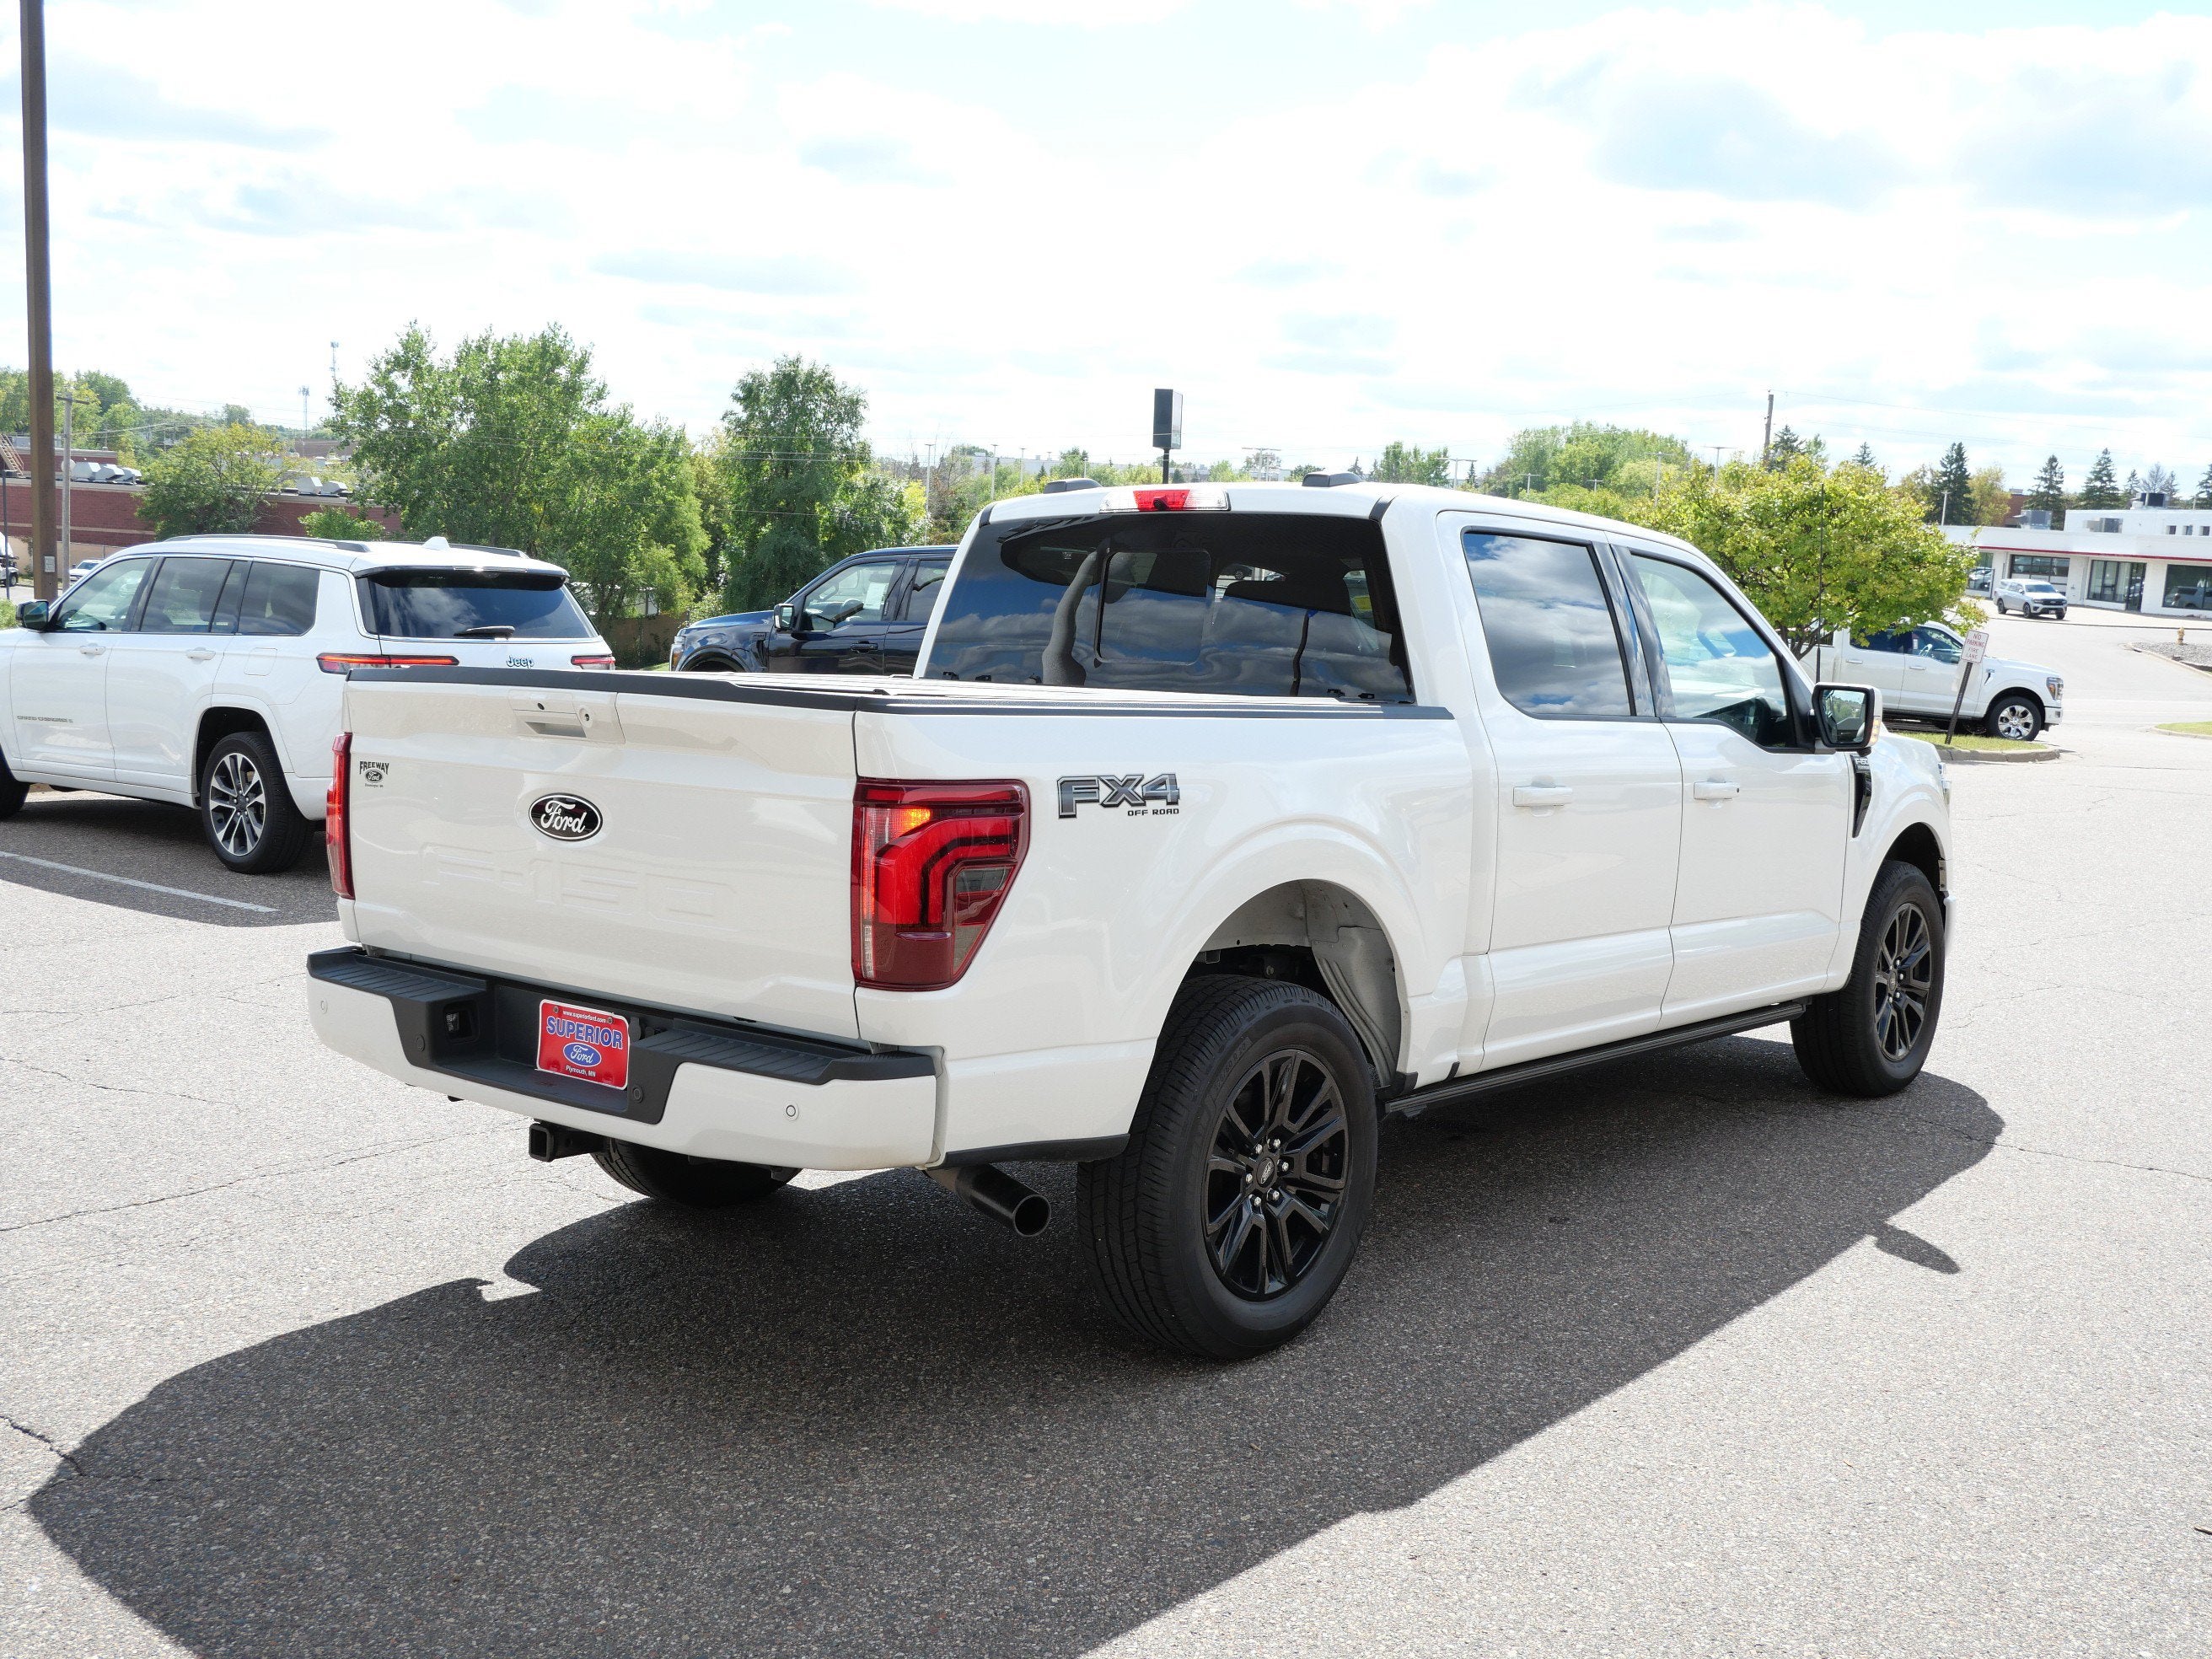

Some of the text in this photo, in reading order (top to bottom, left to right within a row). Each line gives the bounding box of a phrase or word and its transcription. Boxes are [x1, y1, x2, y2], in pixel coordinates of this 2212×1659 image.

[1966, 639, 1985, 648] PARKING
[506, 654, 534, 669] Jeep
[359, 761, 389, 775] FREEWAY
[368, 772, 380, 780] Ford
[1056, 773, 1180, 819] FX4
[540, 799, 588, 834] Ford
[1152, 808, 1179, 816] ROAD
[563, 1010, 606, 1023] www.superiorford.com
[546, 1015, 623, 1050] SUPERIOR
[570, 1045, 594, 1064] Ford
[566, 1065, 587, 1076] Plymouth,
